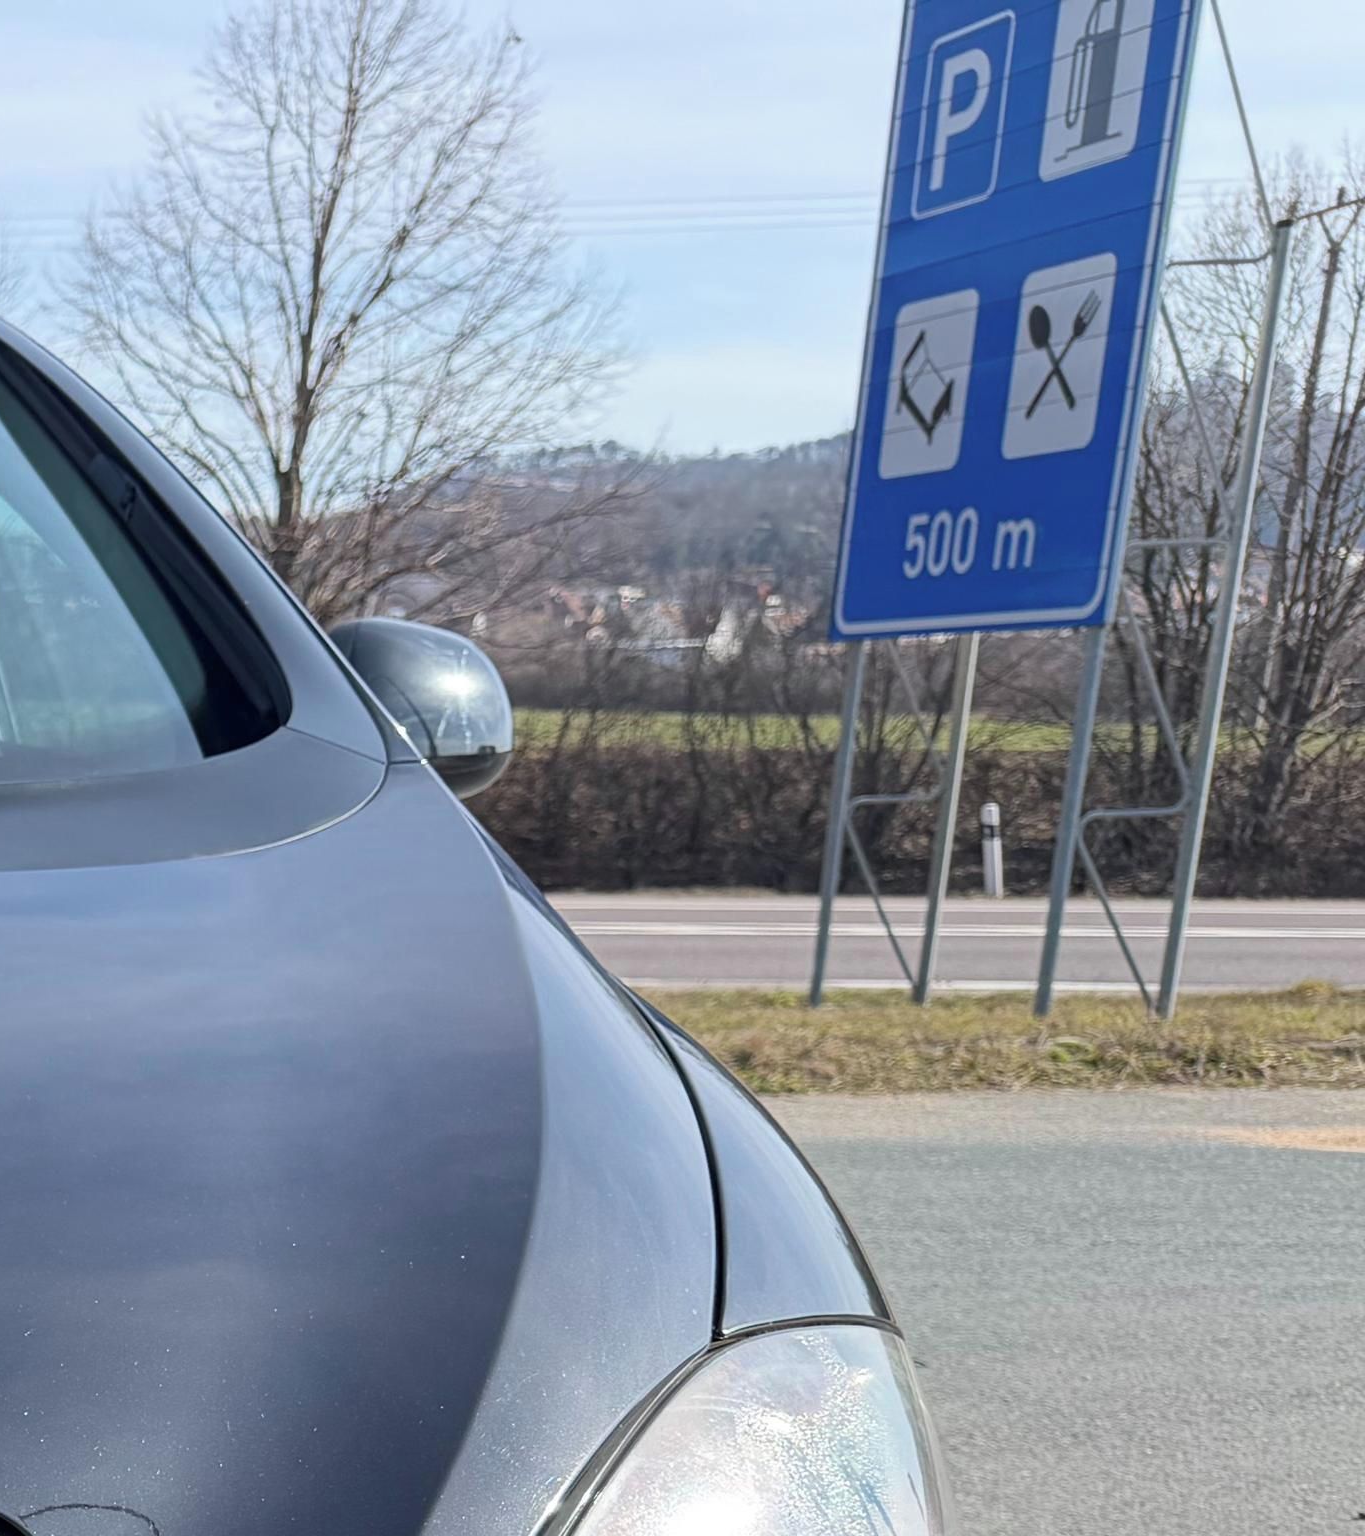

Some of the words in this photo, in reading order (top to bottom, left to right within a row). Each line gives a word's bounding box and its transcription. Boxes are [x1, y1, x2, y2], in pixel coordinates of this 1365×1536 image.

[929, 48, 991, 191] P
[902, 507, 979, 579] 500
[992, 518, 1036, 571] m
